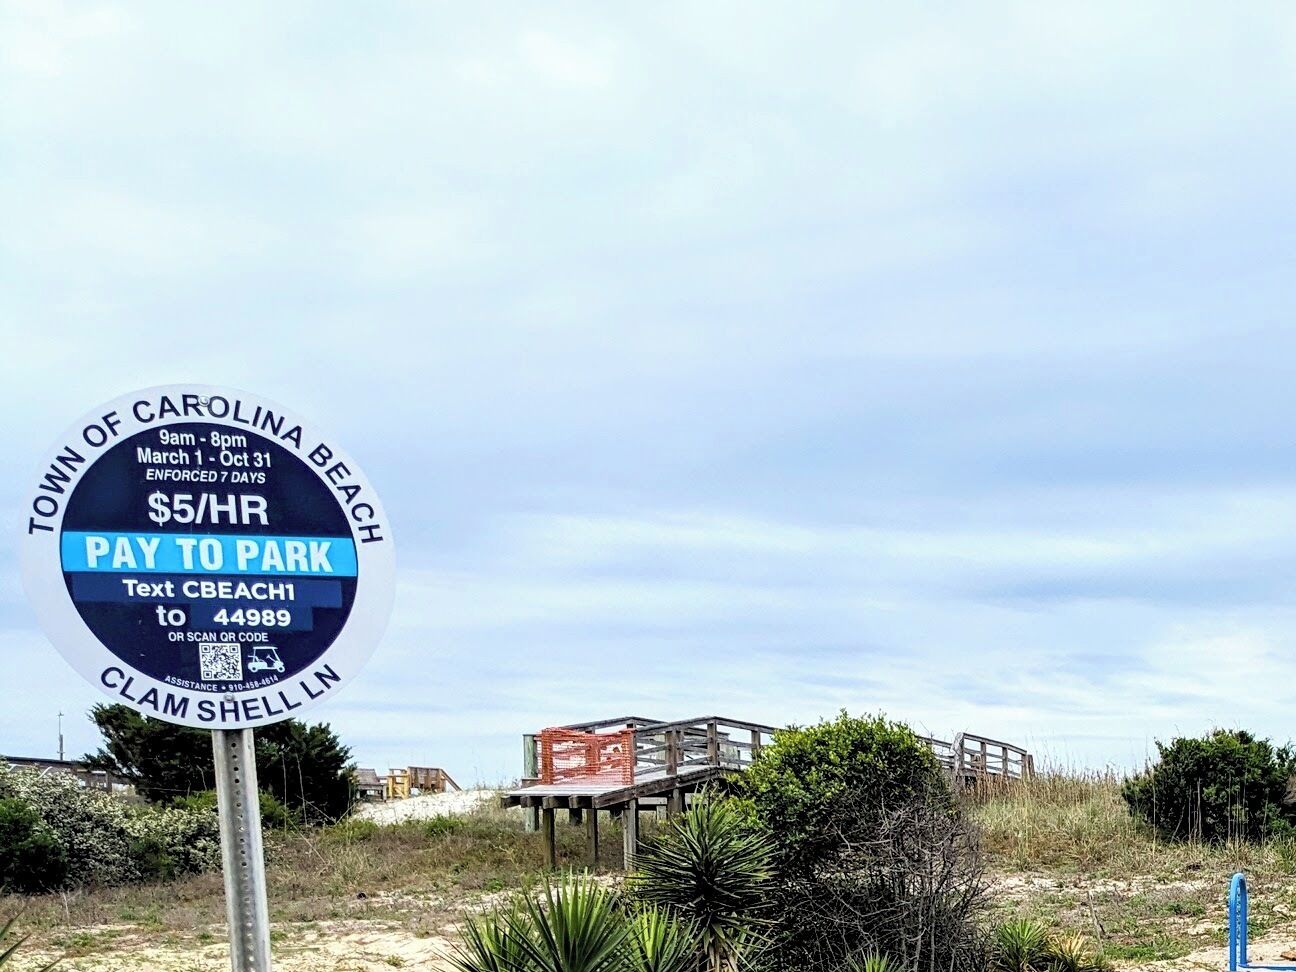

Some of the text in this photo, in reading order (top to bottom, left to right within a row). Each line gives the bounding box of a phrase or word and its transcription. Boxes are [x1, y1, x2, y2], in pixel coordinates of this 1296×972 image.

[159, 429, 196, 446] 9am
[210, 431, 247, 450] 8pm
[29, 393, 384, 544] TOWN OF CAROLINA BEACH
[137, 447, 190, 465] March
[195, 449, 203, 465] 1
[220, 451, 249, 467] Oct
[253, 452, 272, 468] 31
[146, 469, 266, 484] ENFORCED 7 DAYS
[148, 490, 270, 526] $5/HR
[85, 535, 334, 573] PAY TO PARK
[122, 578, 295, 601] Text CBEACH1
[156, 605, 291, 627] to 44989
[168, 631, 269, 642] OR SCAN QR CODE
[100, 664, 342, 722] CLAM SHELL LN
[164, 675, 279, 691] ASSISTANCE 910-458-4614
